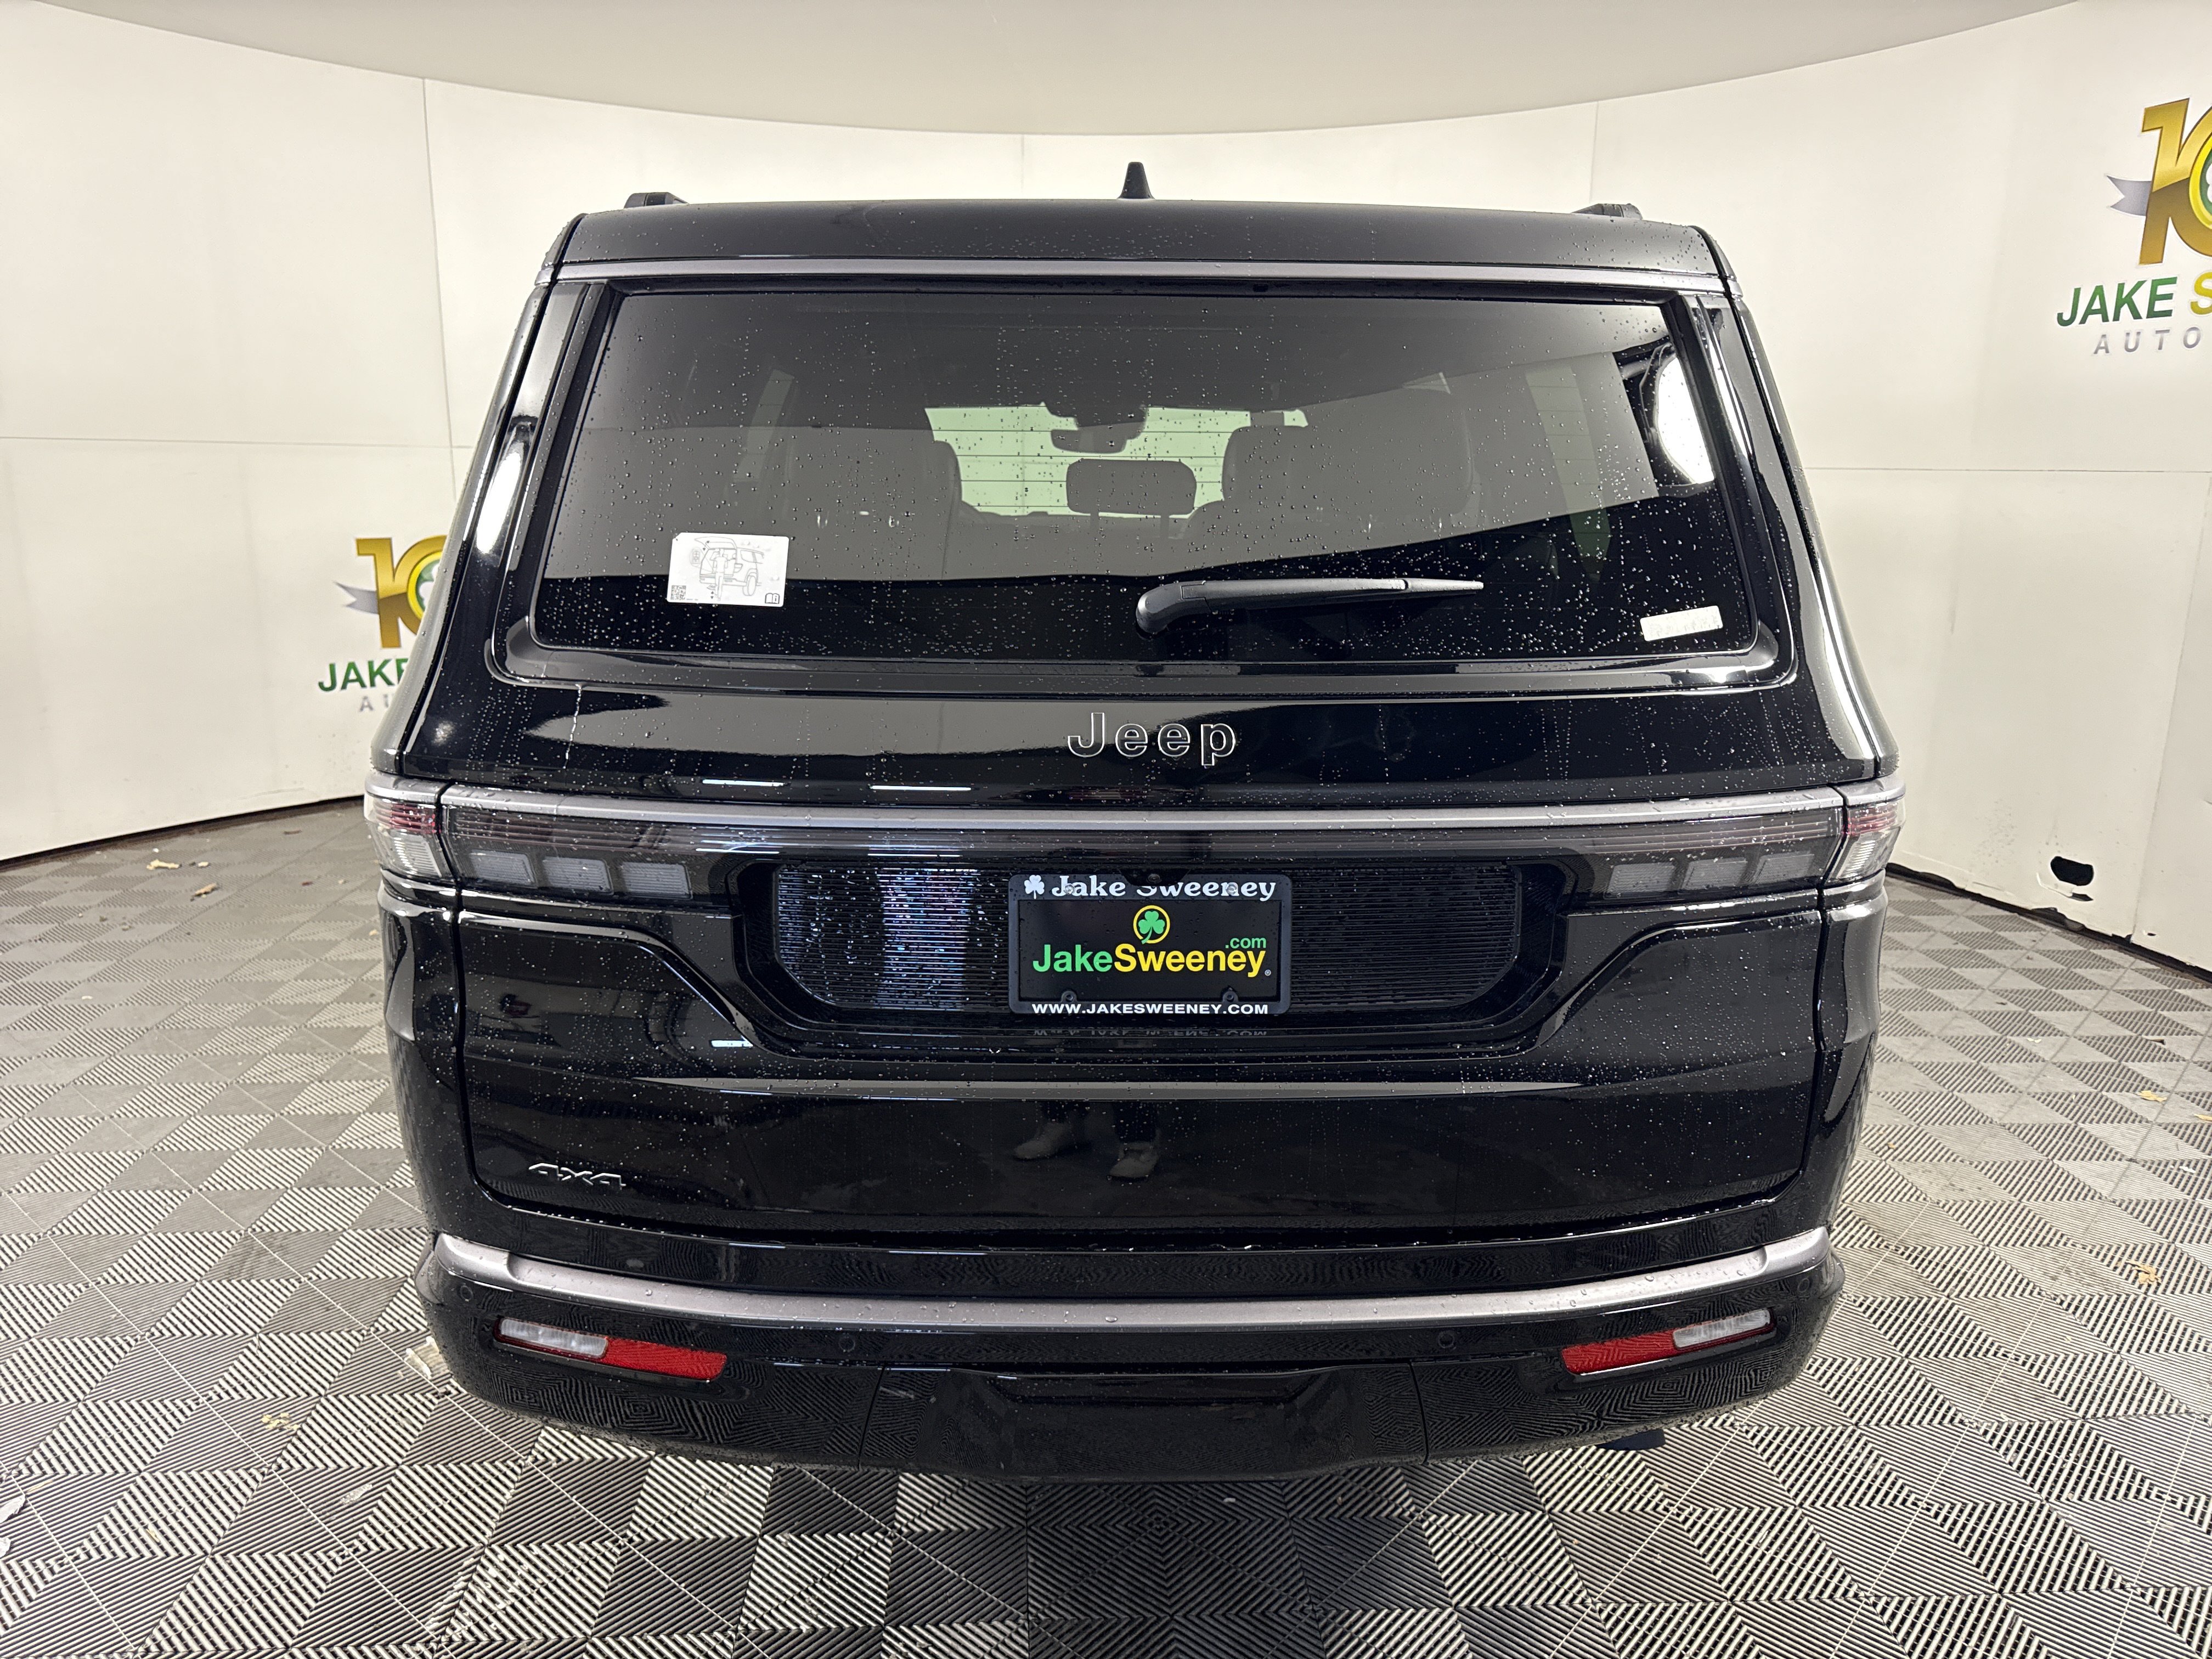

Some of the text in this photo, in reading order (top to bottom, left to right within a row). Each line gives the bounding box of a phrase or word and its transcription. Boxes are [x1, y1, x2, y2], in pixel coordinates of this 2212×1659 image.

[2057, 276, 2178, 327] JAKE
[2094, 327, 2202, 354] AUTO
[1068, 712, 1236, 766] Jeep
[1052, 875, 1126, 897] Jake
[1032, 943, 1266, 978] JakeSweeney
[1032, 1003, 1268, 1015] WWW.JAKESWEENEY.COM
